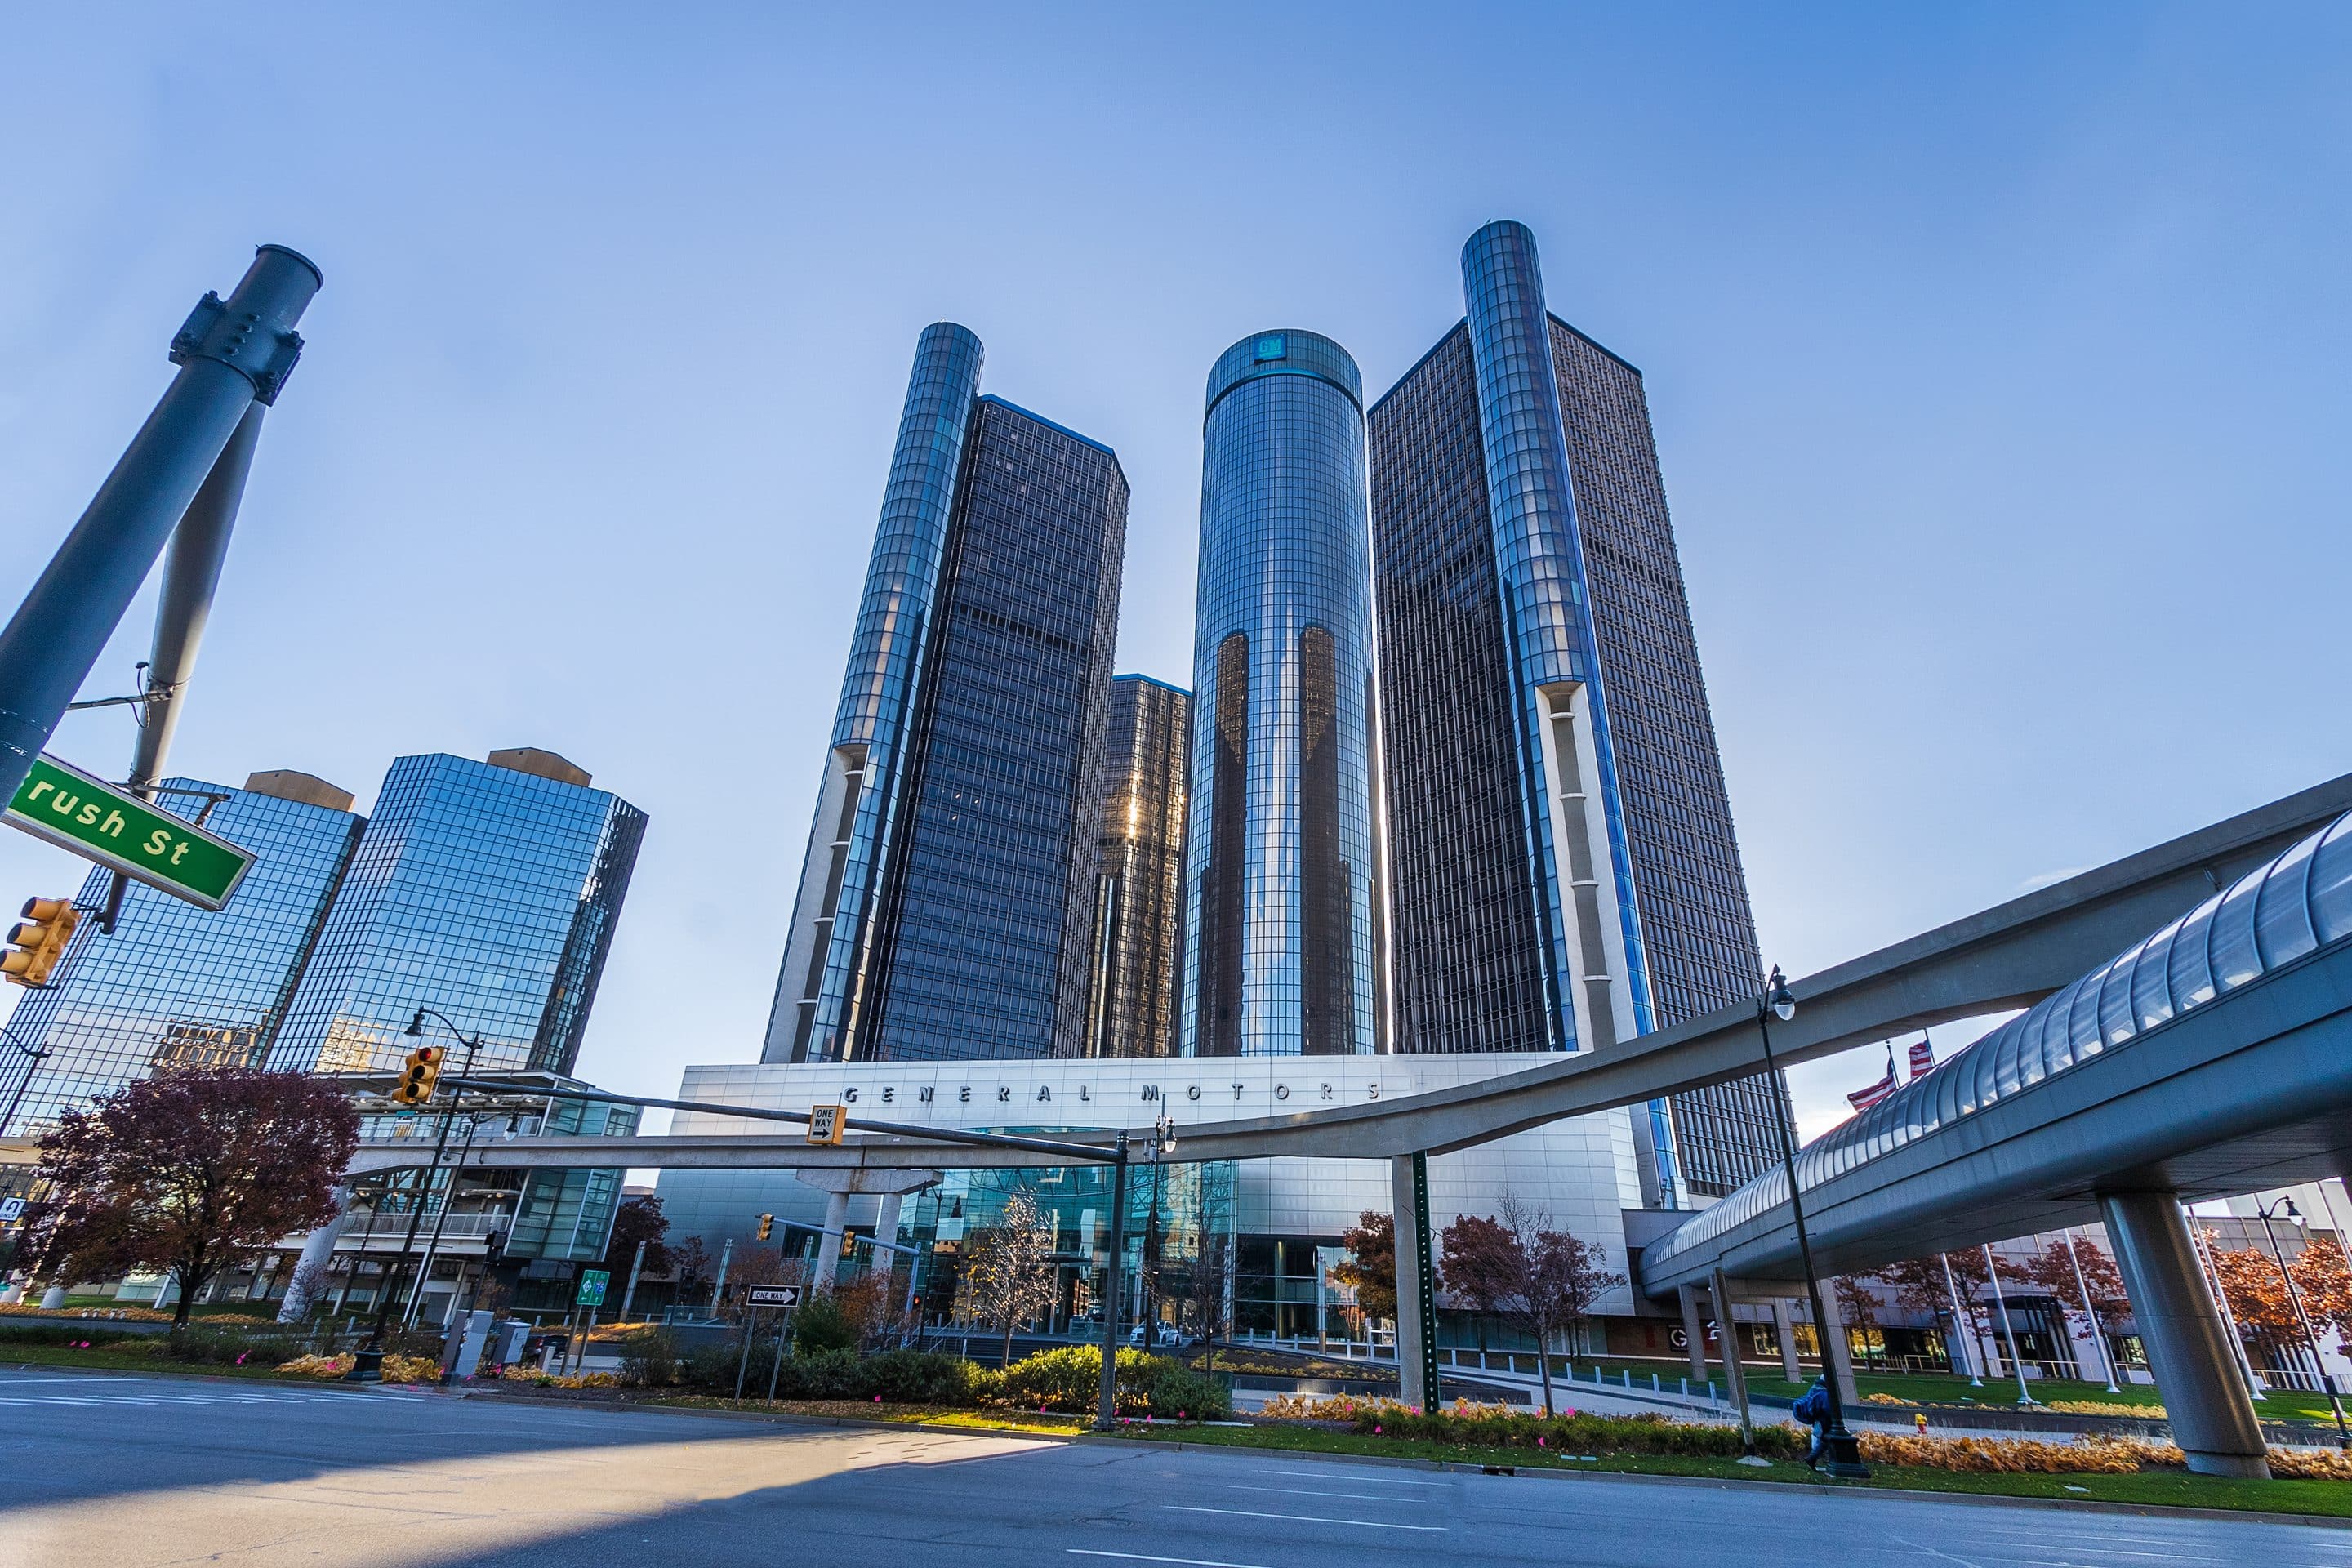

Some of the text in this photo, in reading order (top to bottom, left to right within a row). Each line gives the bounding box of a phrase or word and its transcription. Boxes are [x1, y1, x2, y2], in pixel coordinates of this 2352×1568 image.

[1259, 338, 1281, 353] GM
[22, 771, 189, 866] rush St
[843, 1083, 1379, 1102] GENERAL MOTORS
[817, 1109, 834, 1118] ONE
[814, 1119, 833, 1127] WAY
